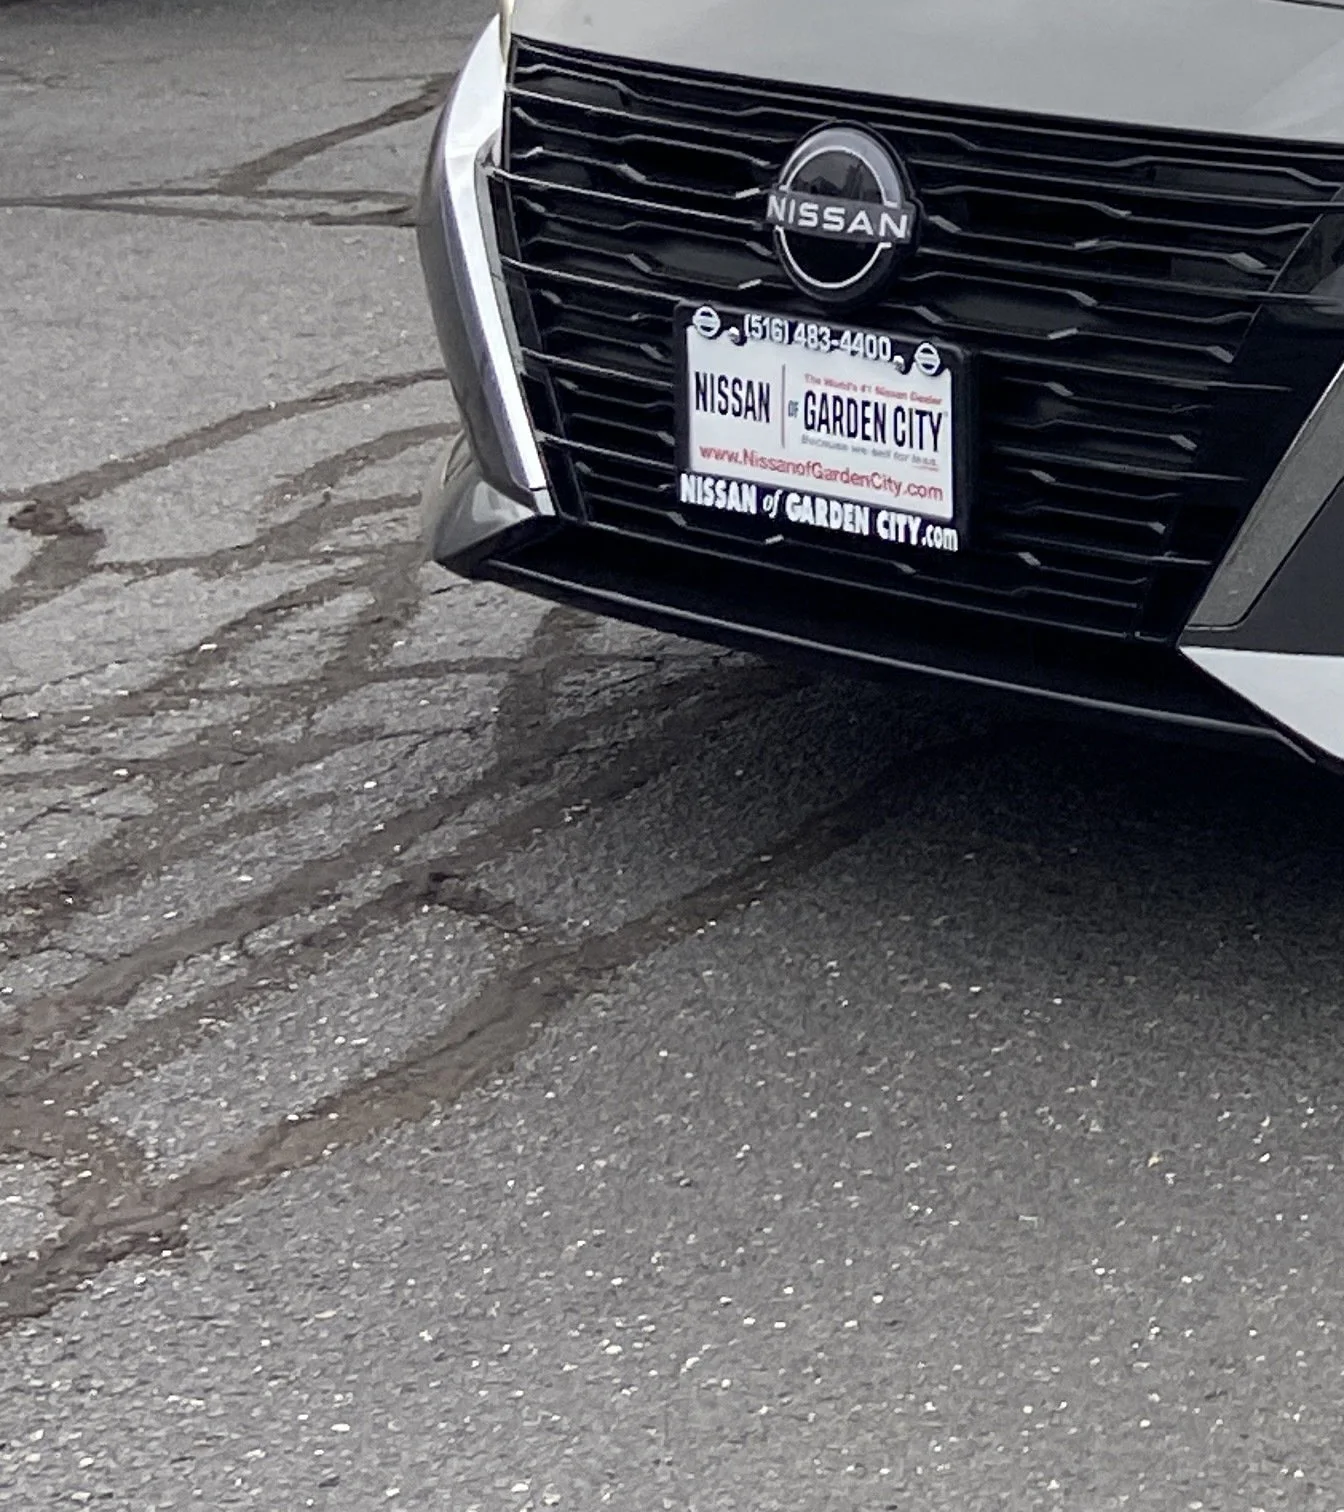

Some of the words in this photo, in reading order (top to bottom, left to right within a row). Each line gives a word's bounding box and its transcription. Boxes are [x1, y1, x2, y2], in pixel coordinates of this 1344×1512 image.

[767, 194, 908, 239] NISSAN
[743, 314, 790, 345] (516)
[793, 322, 892, 362] 483-4400
[694, 371, 771, 423] NISSAN
[803, 389, 887, 445] GARDEN
[893, 405, 943, 453] CITY
[698, 445, 944, 501] www.NissanofGardenCity.com
[680, 473, 757, 514] NISSAN
[762, 489, 782, 518] of
[785, 492, 870, 536] GARDEN
[876, 509, 959, 552] CITY.com
